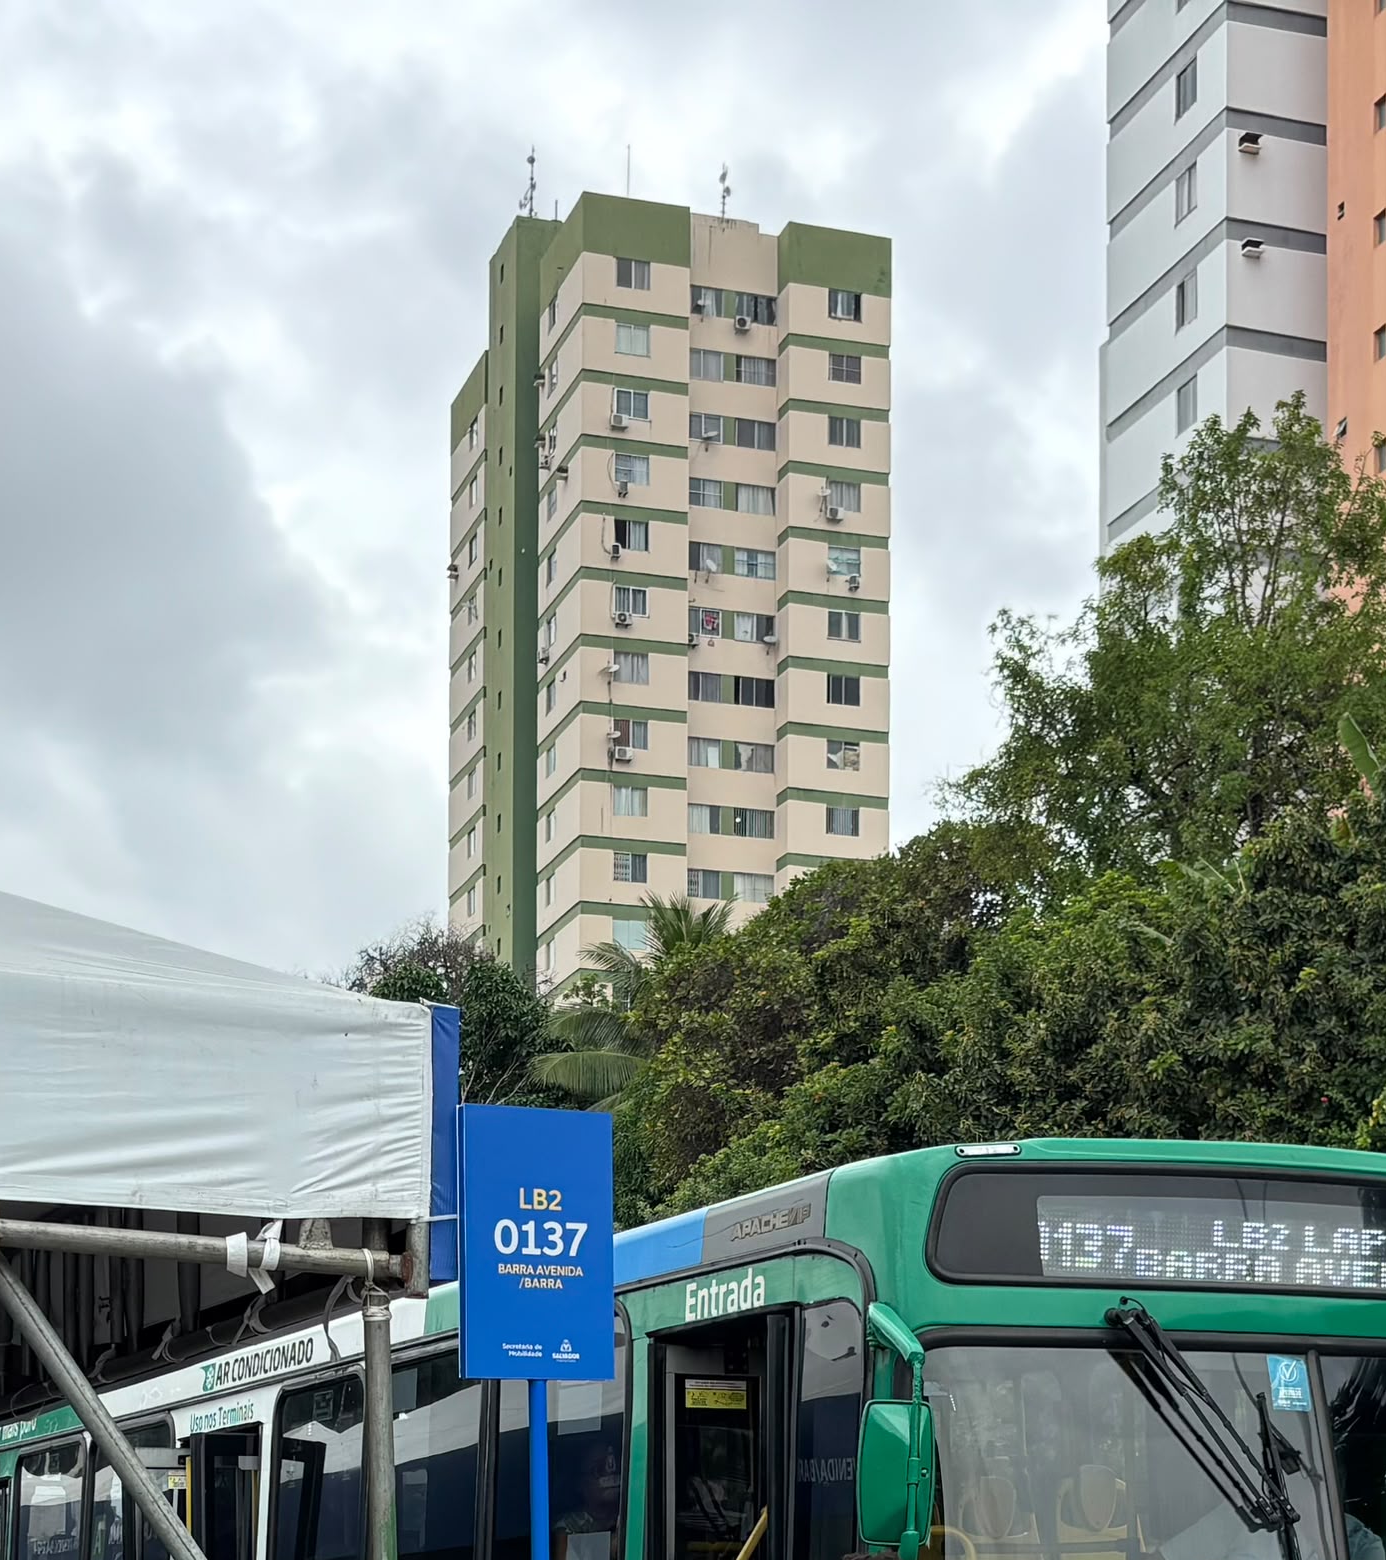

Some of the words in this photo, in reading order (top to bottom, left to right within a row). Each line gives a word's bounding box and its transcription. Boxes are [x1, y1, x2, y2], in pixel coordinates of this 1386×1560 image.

[519, 1187, 562, 1211] LB2
[493, 1218, 588, 1257] 0137
[498, 1263, 534, 1275] BARRA
[534, 1264, 583, 1277] AVENIDA
[1135, 1248, 1281, 1283] BARRA
[518, 1277, 563, 1289] /BARRA
[685, 1267, 766, 1322] Entrada
[215, 1361, 231, 1387] AR
[231, 1337, 314, 1382] CONDICIONADO
[189, 1413, 203, 1433] Uso
[218, 1399, 254, 1427] Terminais
